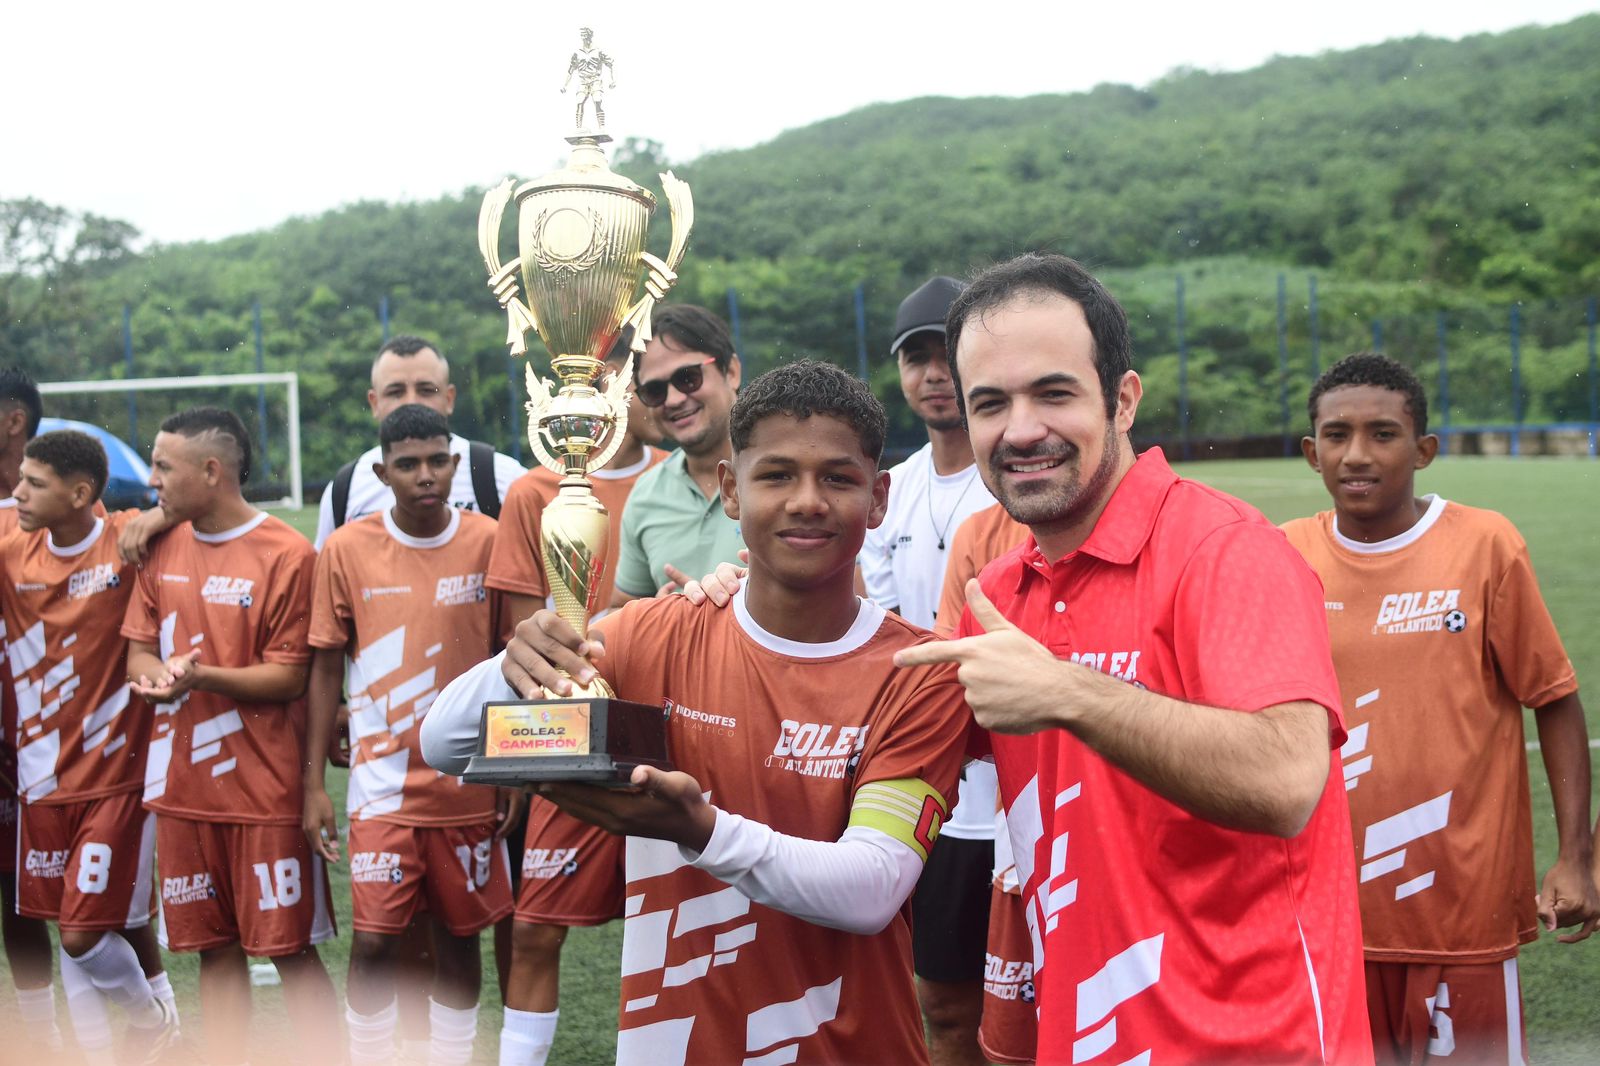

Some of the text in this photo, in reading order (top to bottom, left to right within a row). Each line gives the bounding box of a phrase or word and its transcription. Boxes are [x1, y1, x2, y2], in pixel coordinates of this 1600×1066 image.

[201, 574, 255, 597] GOLEA
[436, 573, 484, 601] GOLEA
[1376, 589, 1461, 625] GOLEA
[500, 736, 577, 750] CAMPEÓN
[511, 727, 566, 736] GOLEA2
[76, 841, 112, 894] 8
[351, 851, 401, 874] GOLEA
[163, 872, 212, 900] GOLEA
[252, 857, 302, 911] 18
